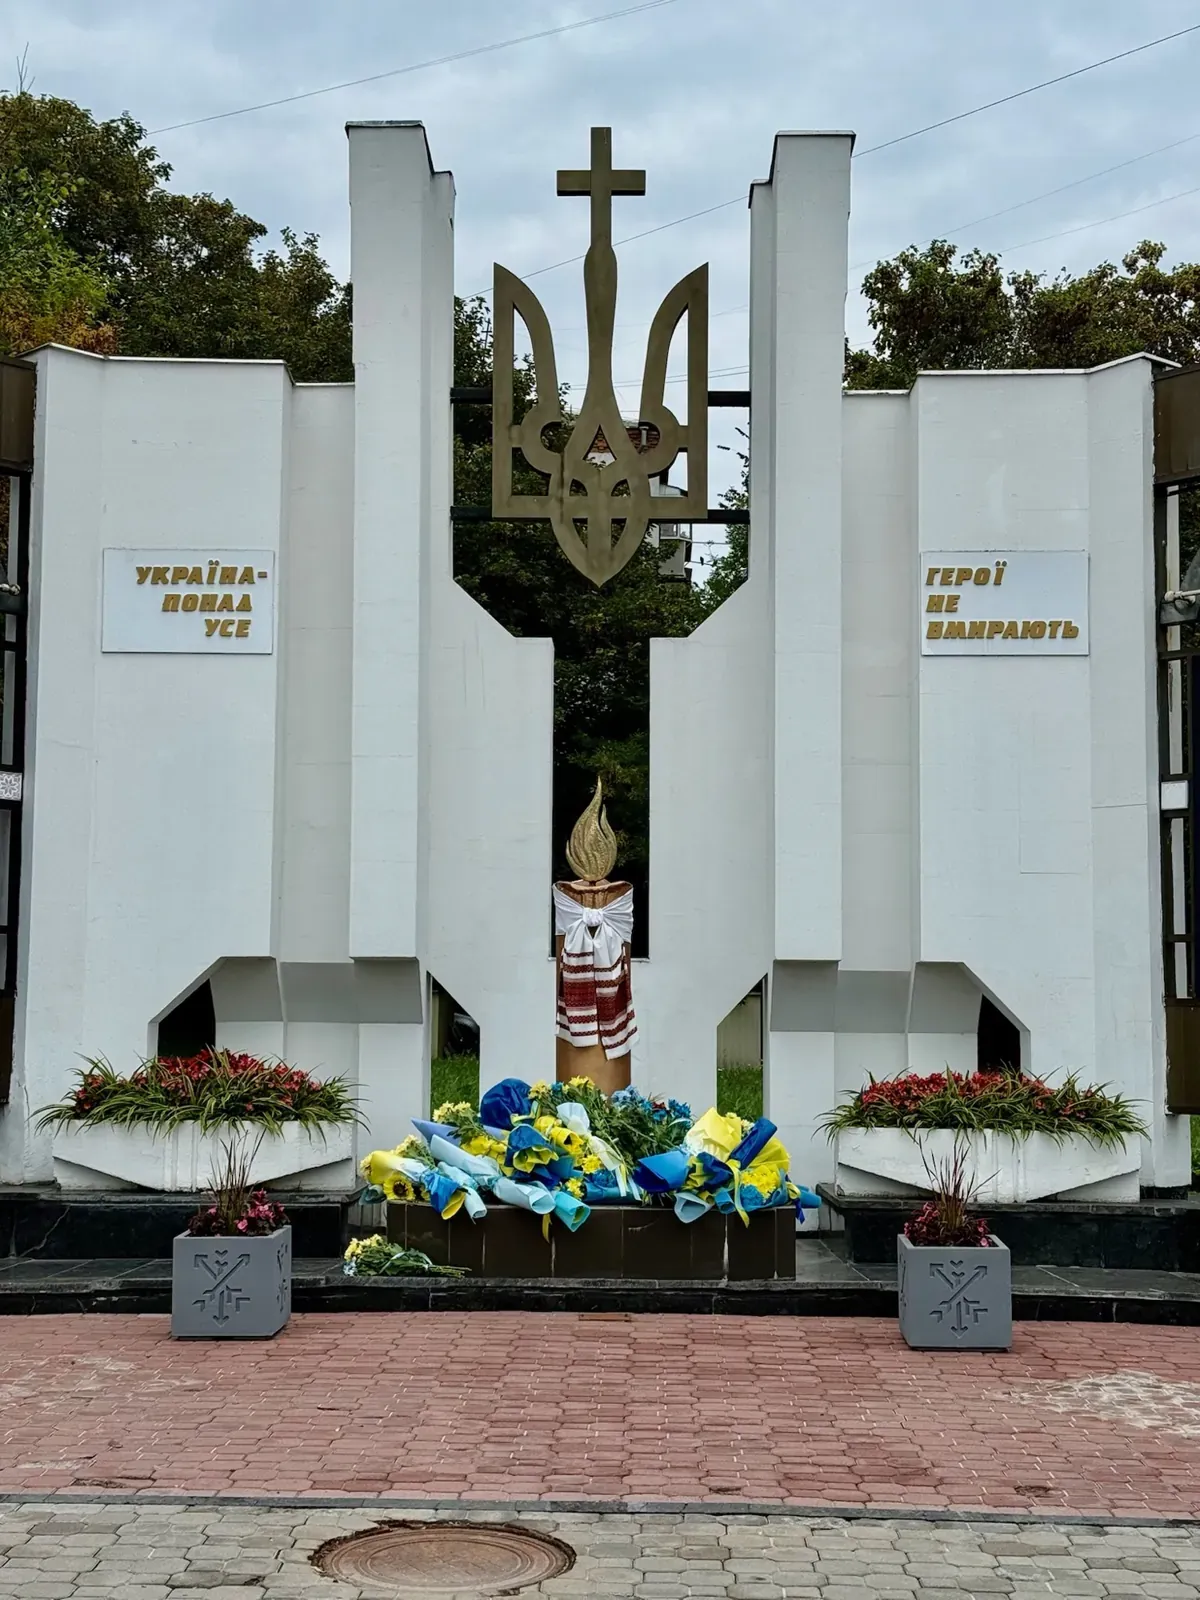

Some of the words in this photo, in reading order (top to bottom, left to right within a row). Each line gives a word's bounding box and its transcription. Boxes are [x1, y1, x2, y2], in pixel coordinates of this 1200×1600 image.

[926, 561, 1007, 586] ГЕРОЇ
[162, 593, 252, 612] ПОНАД
[926, 594, 961, 613] НЕ
[205, 619, 251, 637] УСЕ
[926, 620, 1080, 639] ВМИРАЮТЬ
